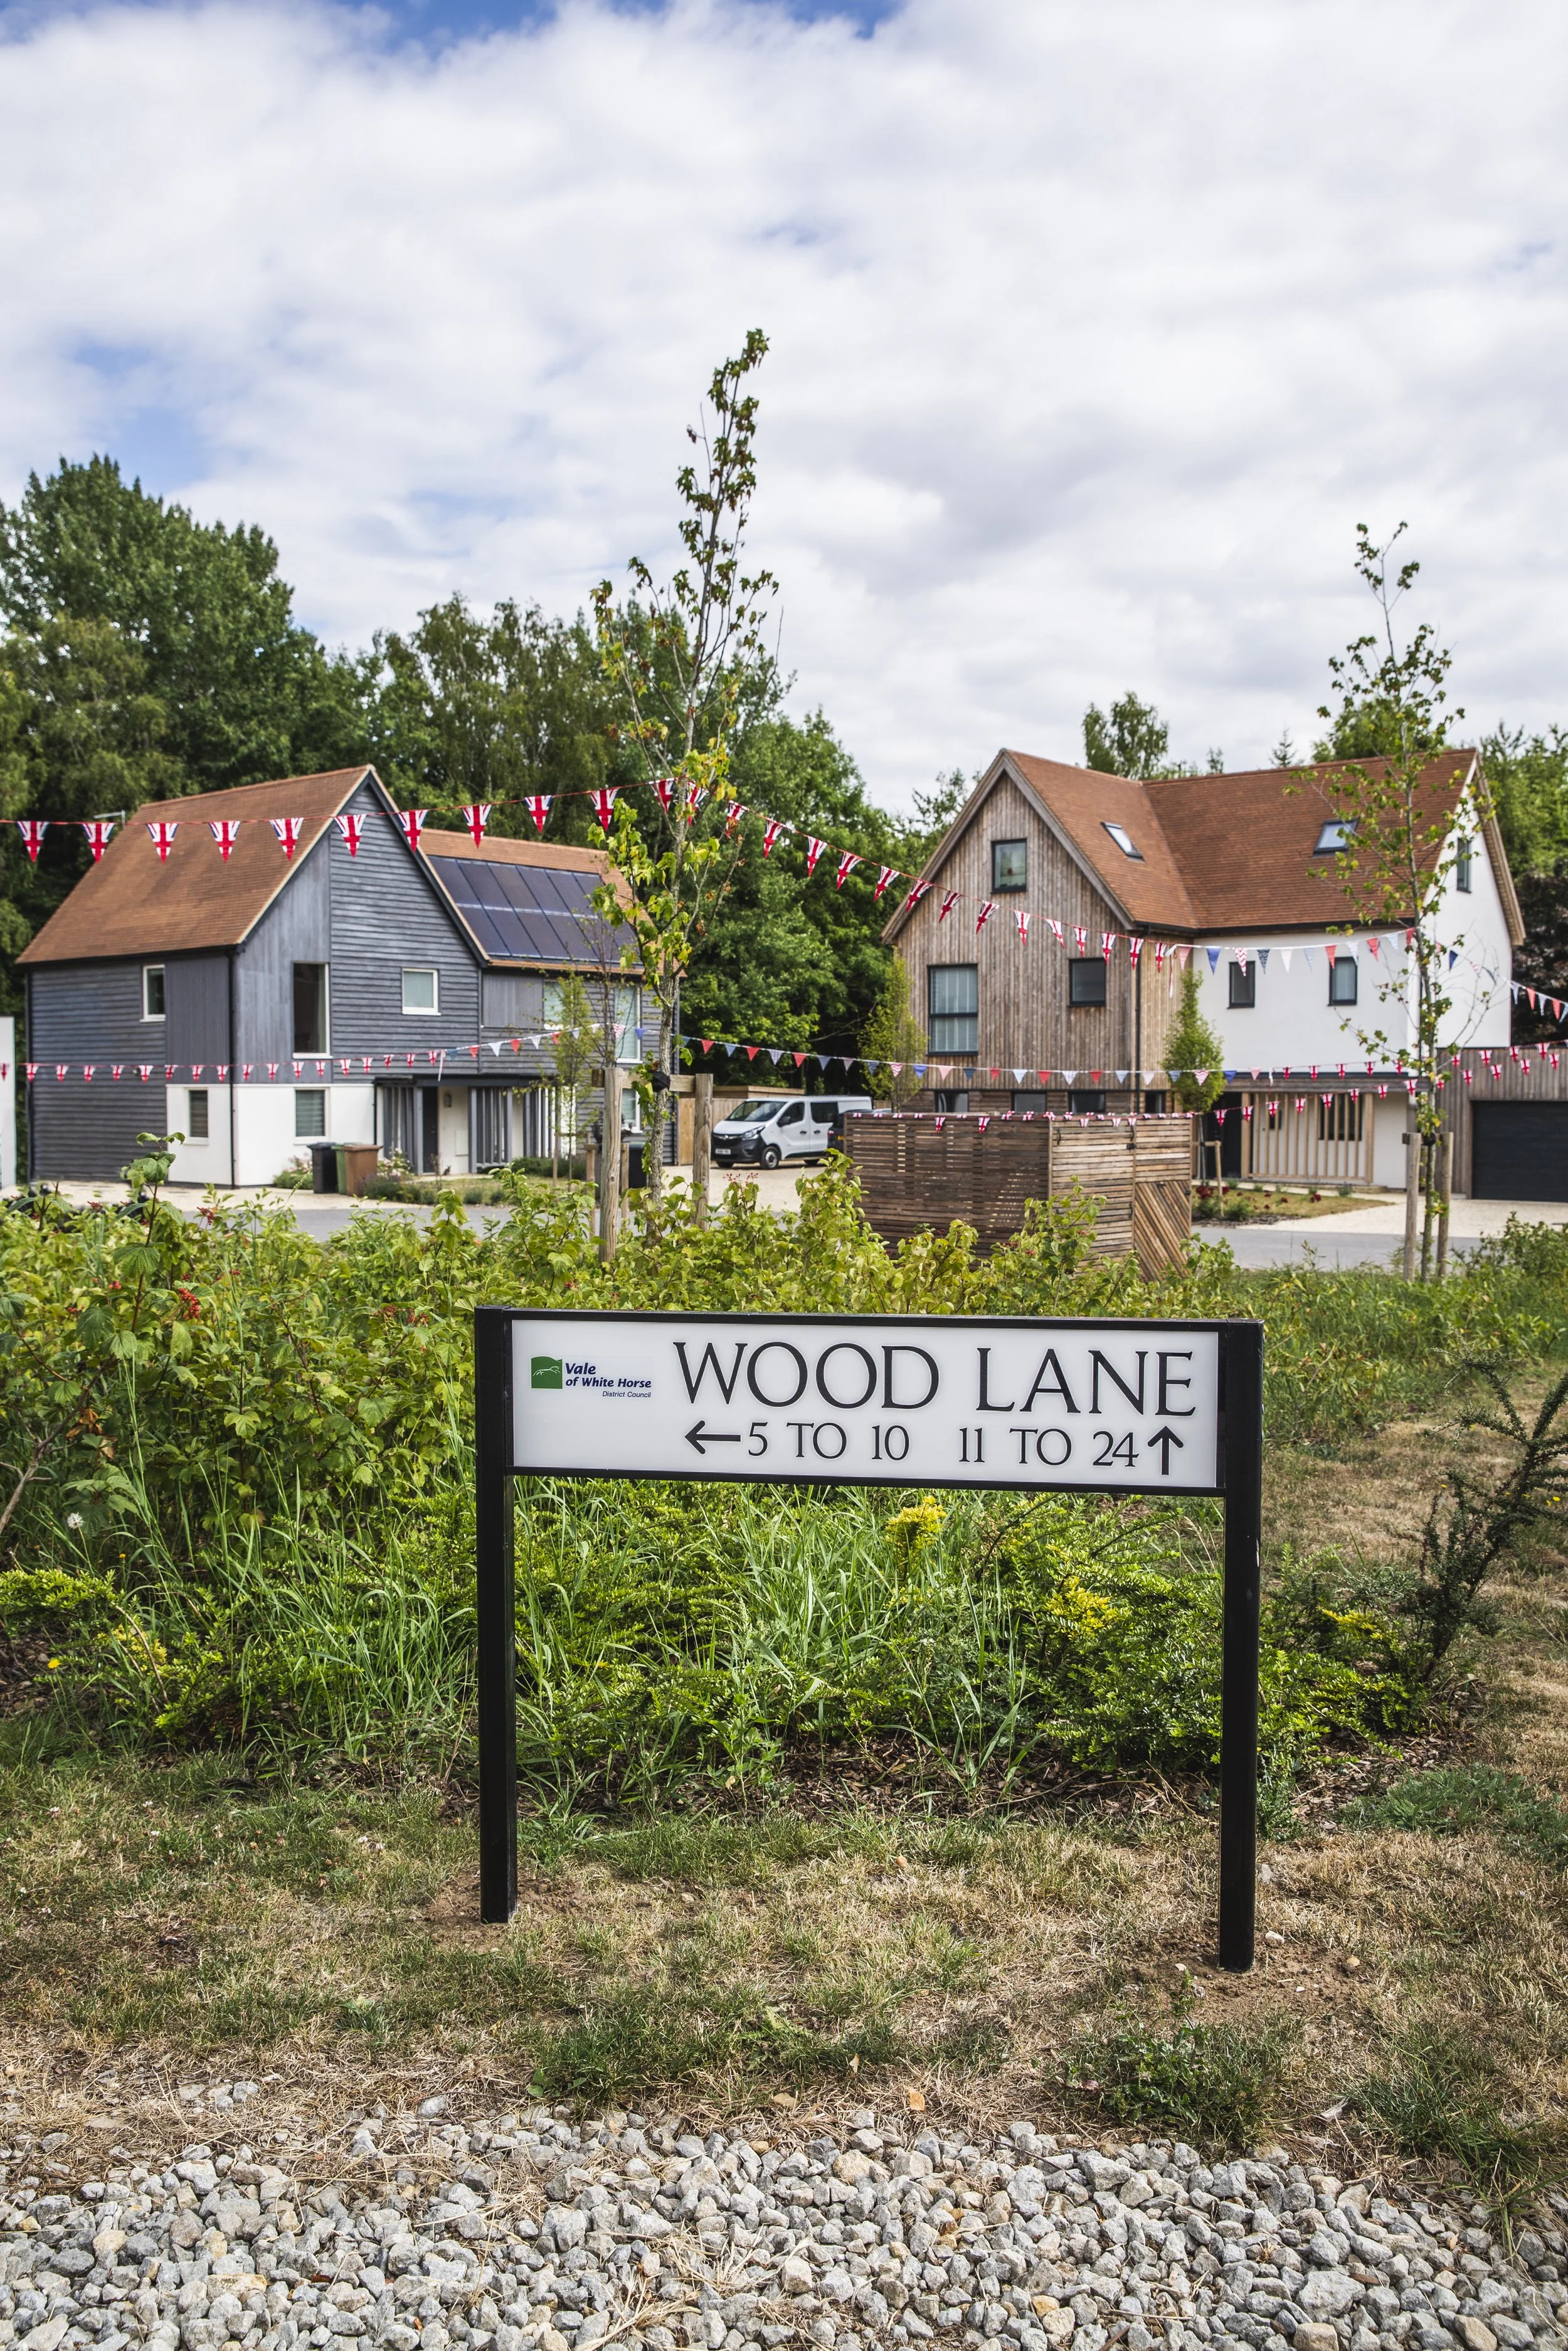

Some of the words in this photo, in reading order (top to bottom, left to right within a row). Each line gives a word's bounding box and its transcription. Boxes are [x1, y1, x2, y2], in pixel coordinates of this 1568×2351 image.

[565, 1362, 596, 1375] Vale
[565, 1376, 580, 1387] of
[581, 1377, 615, 1388] White
[617, 1378, 652, 1388] Horse
[672, 1341, 940, 1409] WOOD
[976, 1347, 1196, 1417] LANE
[748, 1421, 768, 1457] 5
[786, 1422, 847, 1459] TO
[871, 1425, 909, 1461] 10
[958, 1427, 985, 1463] 11
[1009, 1428, 1072, 1466] TO
[1093, 1431, 1140, 1468] 24
